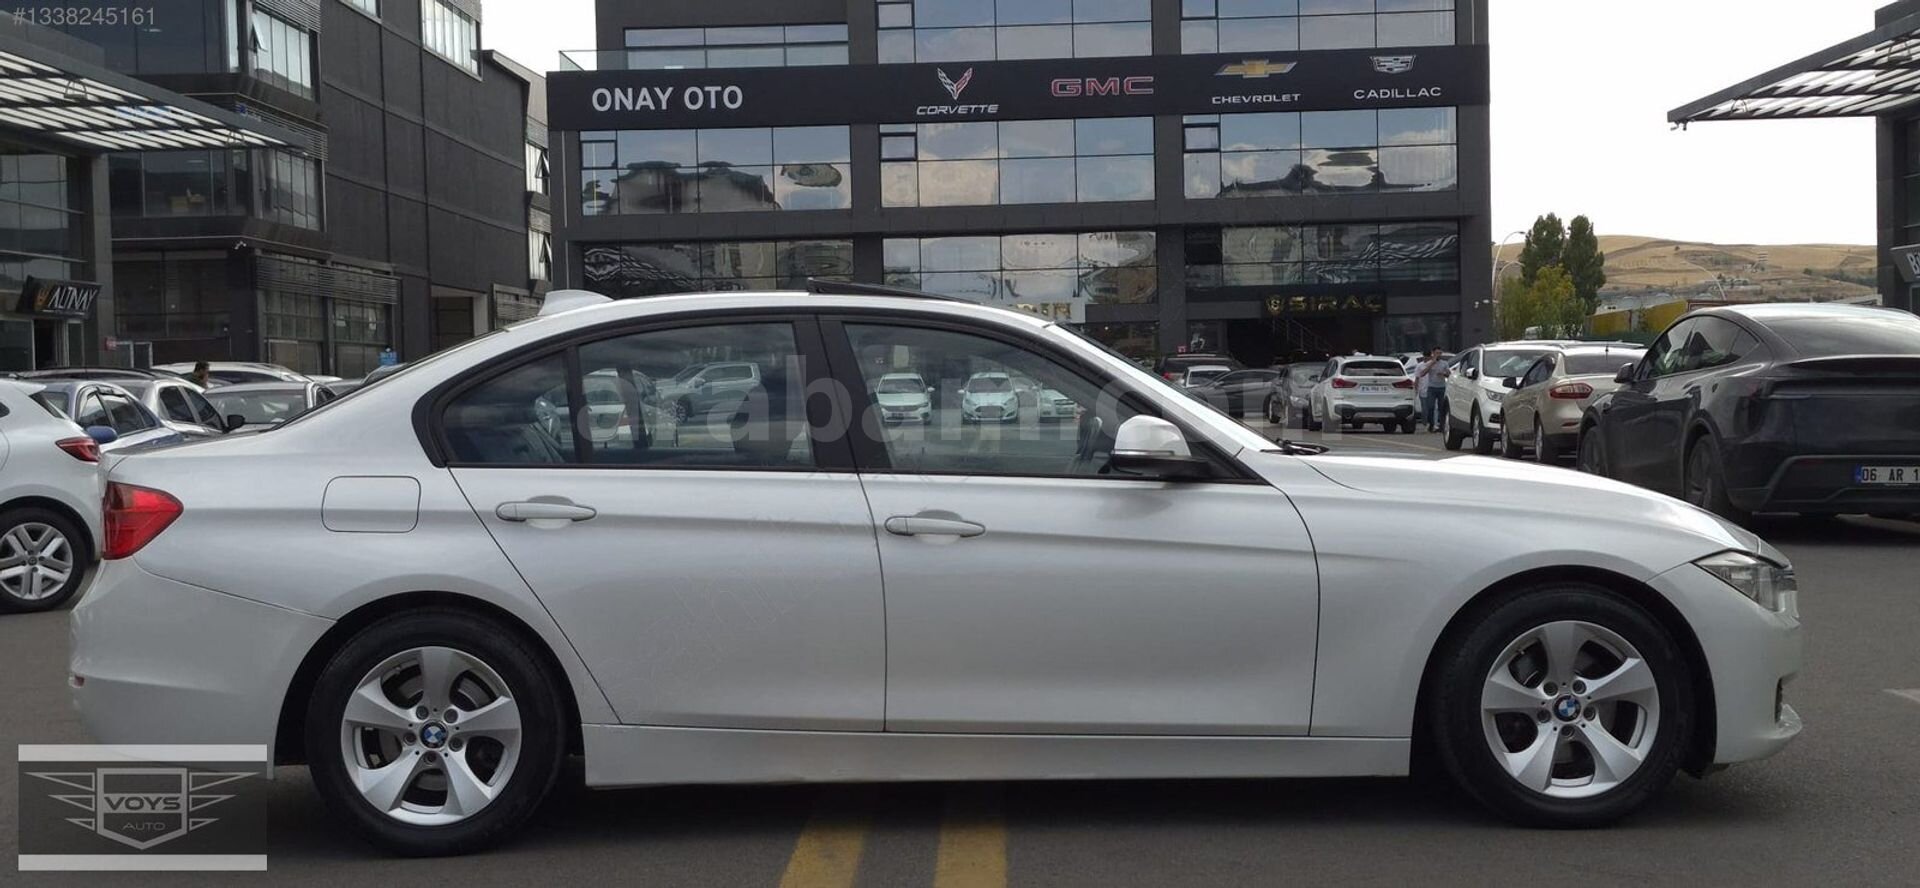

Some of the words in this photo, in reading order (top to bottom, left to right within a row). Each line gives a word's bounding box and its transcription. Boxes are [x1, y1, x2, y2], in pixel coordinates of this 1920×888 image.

[1051, 76, 1154, 97] GMC
[1353, 86, 1442, 100] CADILLAC
[592, 87, 674, 112] ONAY
[683, 85, 743, 110] OTO
[1212, 93, 1301, 105] CHEVROLET
[916, 104, 999, 116] CORVETTE
[1862, 468, 1877, 481] 06
[1888, 468, 1904, 481] AR
